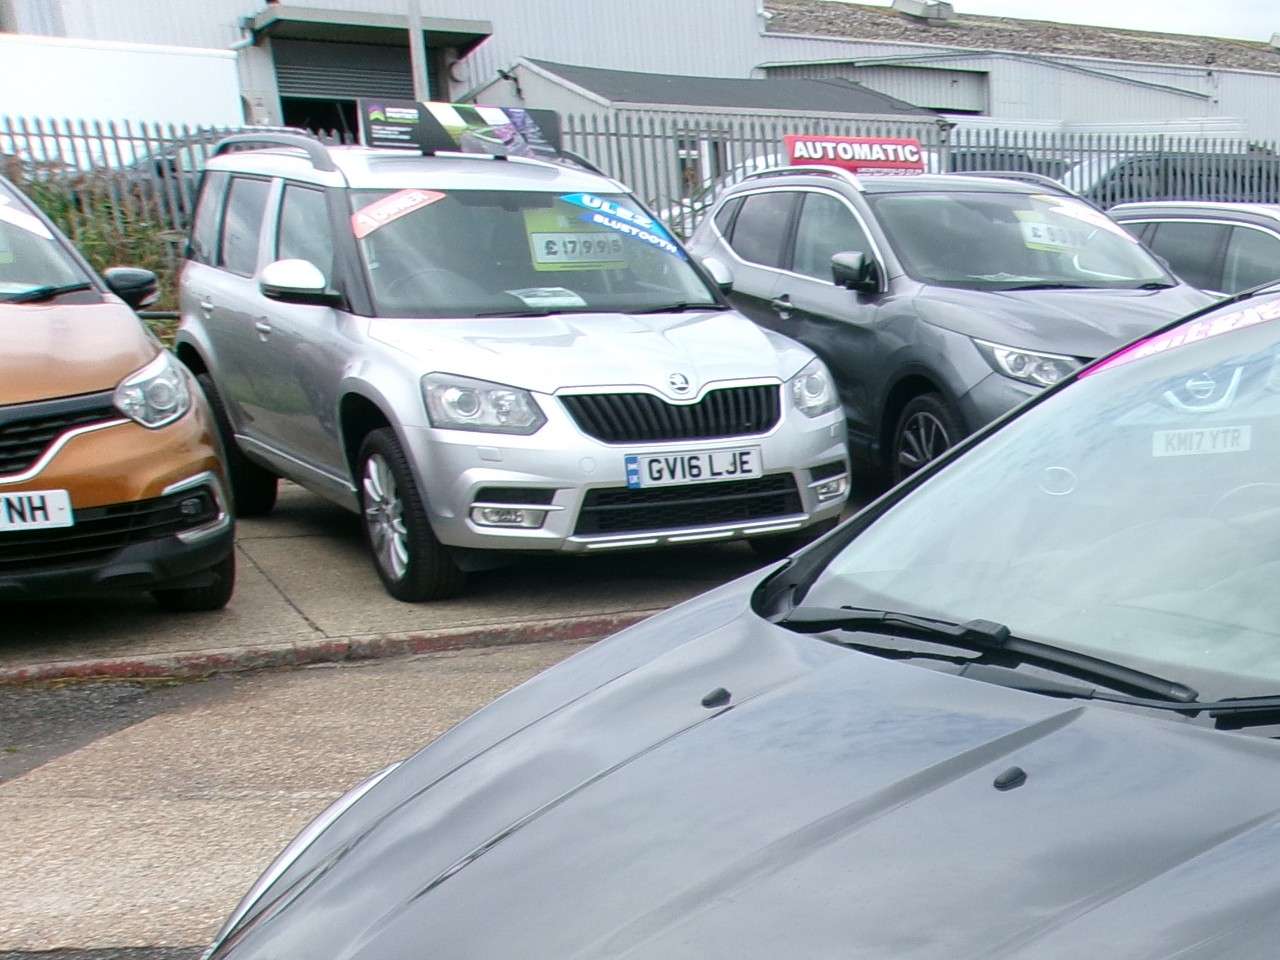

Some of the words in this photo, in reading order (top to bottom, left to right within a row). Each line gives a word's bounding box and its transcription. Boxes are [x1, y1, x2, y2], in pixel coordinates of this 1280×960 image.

[793, 141, 920, 162] AUTOMATIC
[593, 213, 678, 253] BLUETOOTH
[648, 455, 702, 482] GV16
[709, 452, 753, 477] LJE
[0, 495, 49, 523] NH
